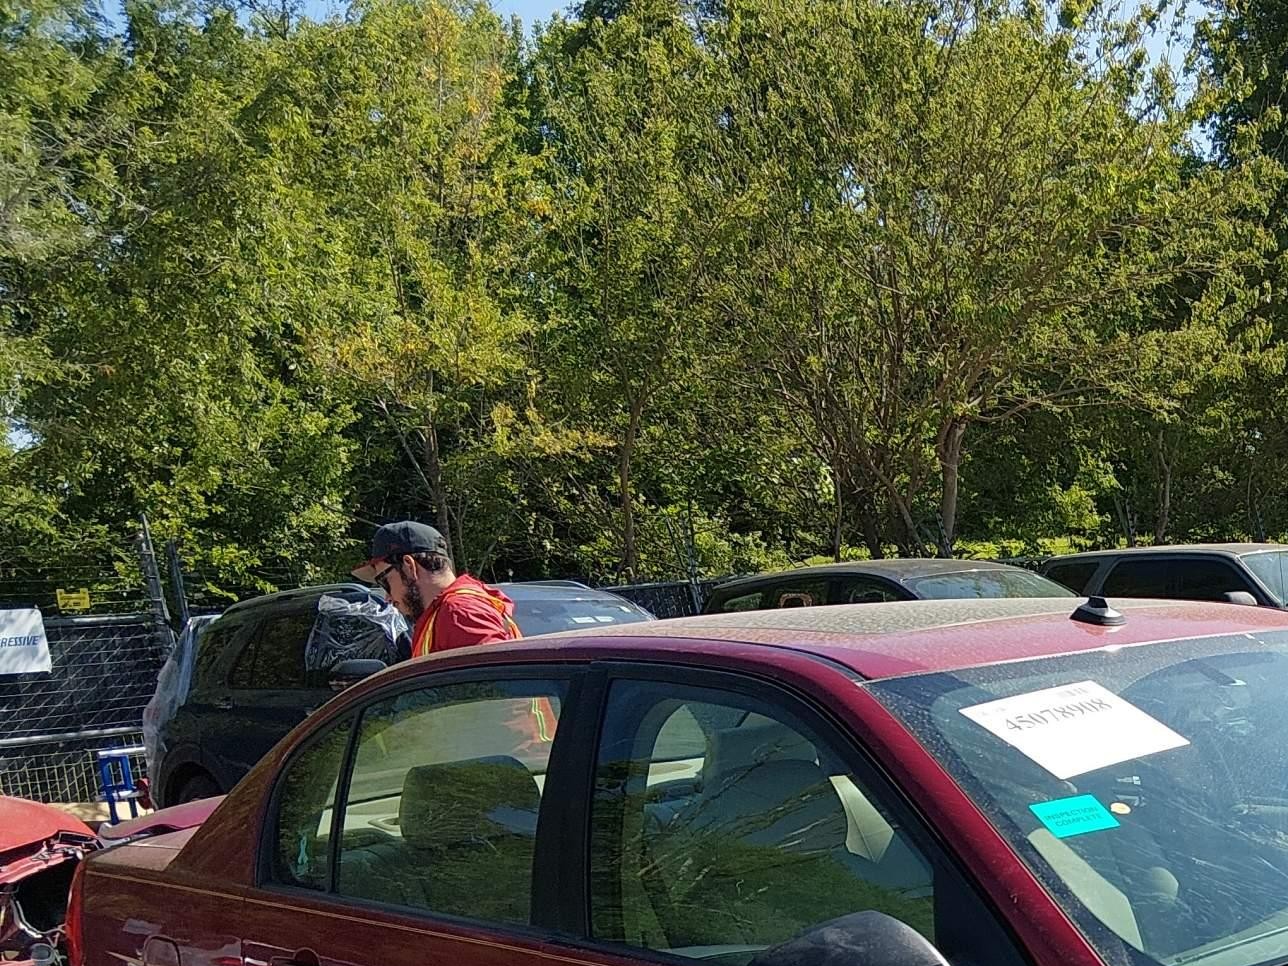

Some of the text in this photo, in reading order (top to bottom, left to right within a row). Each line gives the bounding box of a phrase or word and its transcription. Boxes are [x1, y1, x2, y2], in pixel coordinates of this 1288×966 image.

[1005, 697, 1113, 731] 45078908
[1042, 806, 1099, 821] INSPECTION
[1054, 813, 1103, 827] COMPLETE
